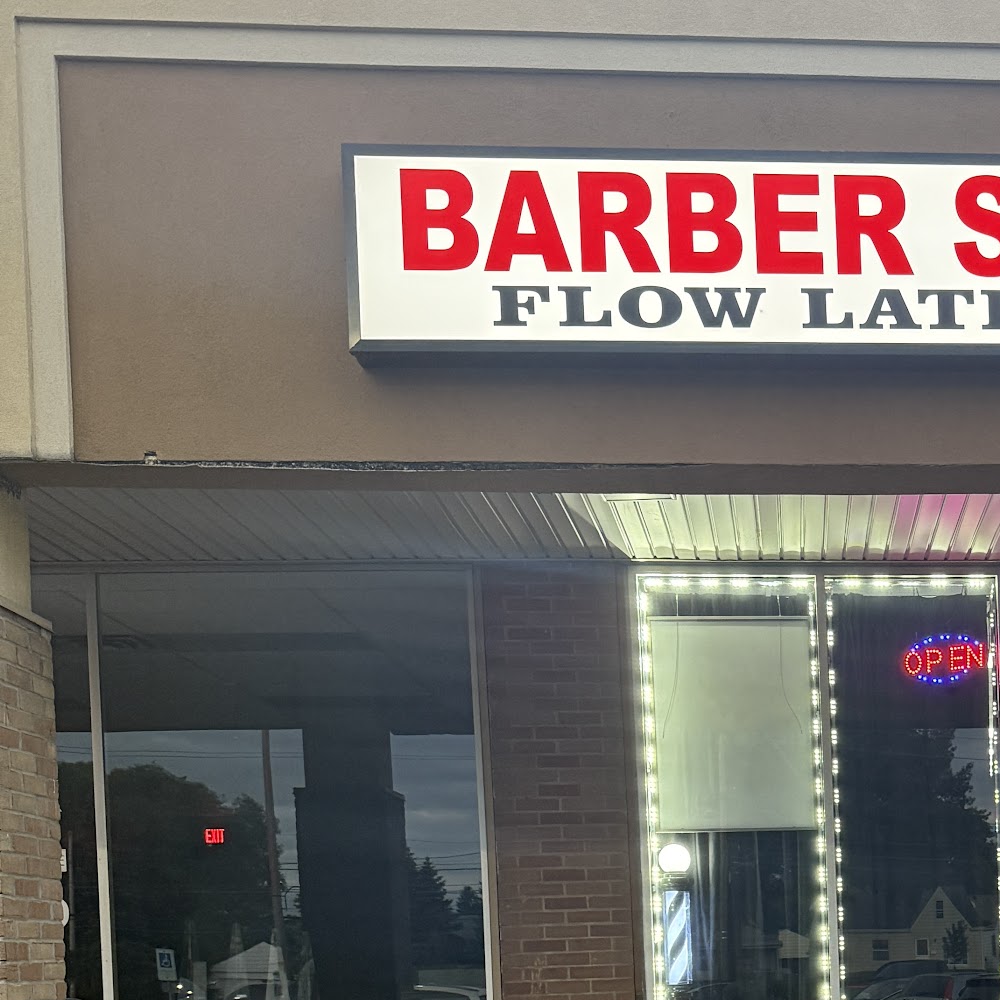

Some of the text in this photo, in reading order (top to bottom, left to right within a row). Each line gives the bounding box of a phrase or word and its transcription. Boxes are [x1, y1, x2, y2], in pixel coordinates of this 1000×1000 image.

[400, 168, 914, 276] BARBER
[492, 286, 766, 329] FLOW
[904, 643, 984, 675] OPEN
[204, 828, 225, 844] EXIT
